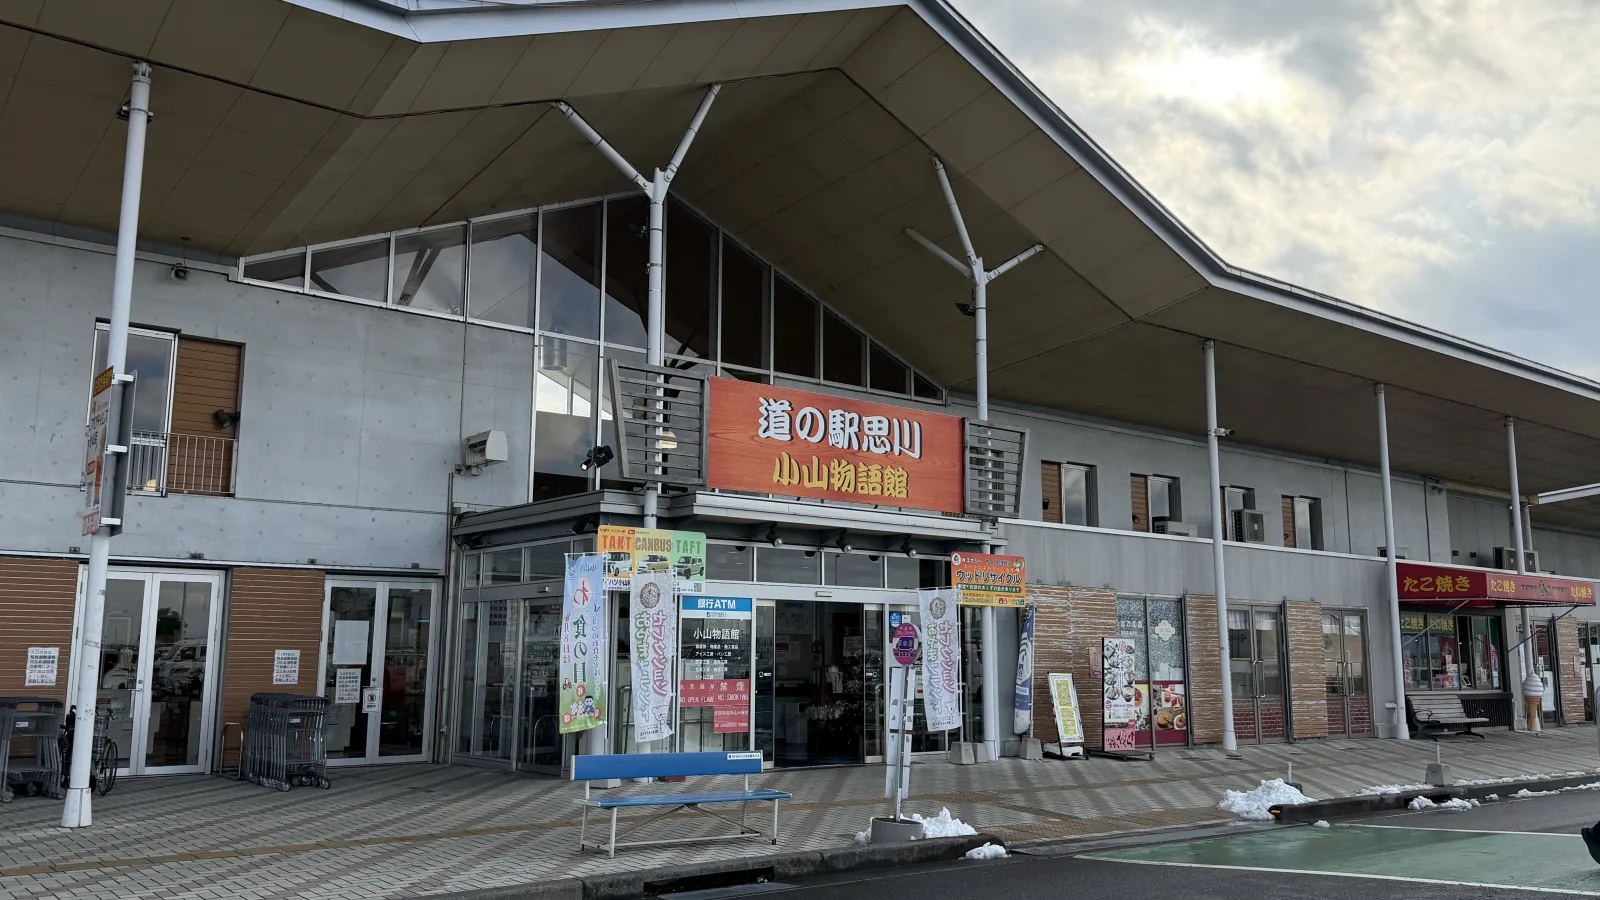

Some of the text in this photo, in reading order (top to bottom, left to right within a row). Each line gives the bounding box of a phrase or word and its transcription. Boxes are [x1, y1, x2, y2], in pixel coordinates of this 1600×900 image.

[758, 396, 922, 459] 道の駅思川
[772, 451, 909, 498] 小山物語館
[634, 537, 672, 552] CANBUS
[675, 539, 702, 554] TAFT
[956, 570, 1022, 585] ウッドリサイクル
[1404, 576, 1471, 593] たこ焼き
[1490, 578, 1516, 593] たこ焼き
[1570, 586, 1592, 599] たい焼き
[697, 599, 736, 609] 銀行ATM
[694, 628, 740, 640] 小山物語館
[719, 681, 745, 692] 禁煙
[717, 693, 749, 701] NO SMOKING
